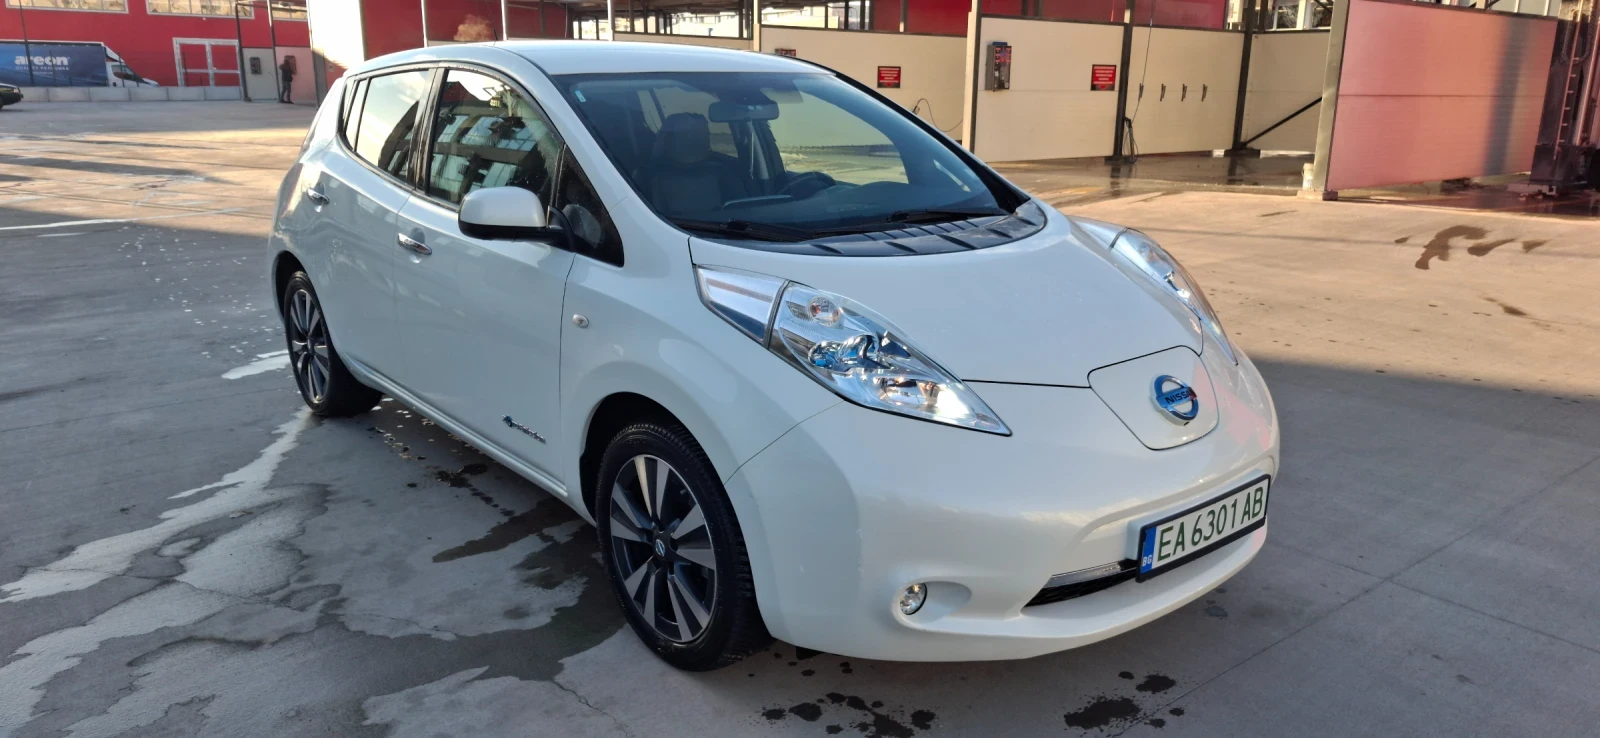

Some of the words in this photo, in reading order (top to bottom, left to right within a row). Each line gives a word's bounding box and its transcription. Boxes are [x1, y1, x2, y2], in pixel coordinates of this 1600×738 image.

[14, 55, 69, 66] areon
[1157, 521, 1185, 562] EA
[1191, 498, 1238, 547] 6301
[1240, 486, 1264, 525] AB
[1142, 554, 1153, 567] BG
